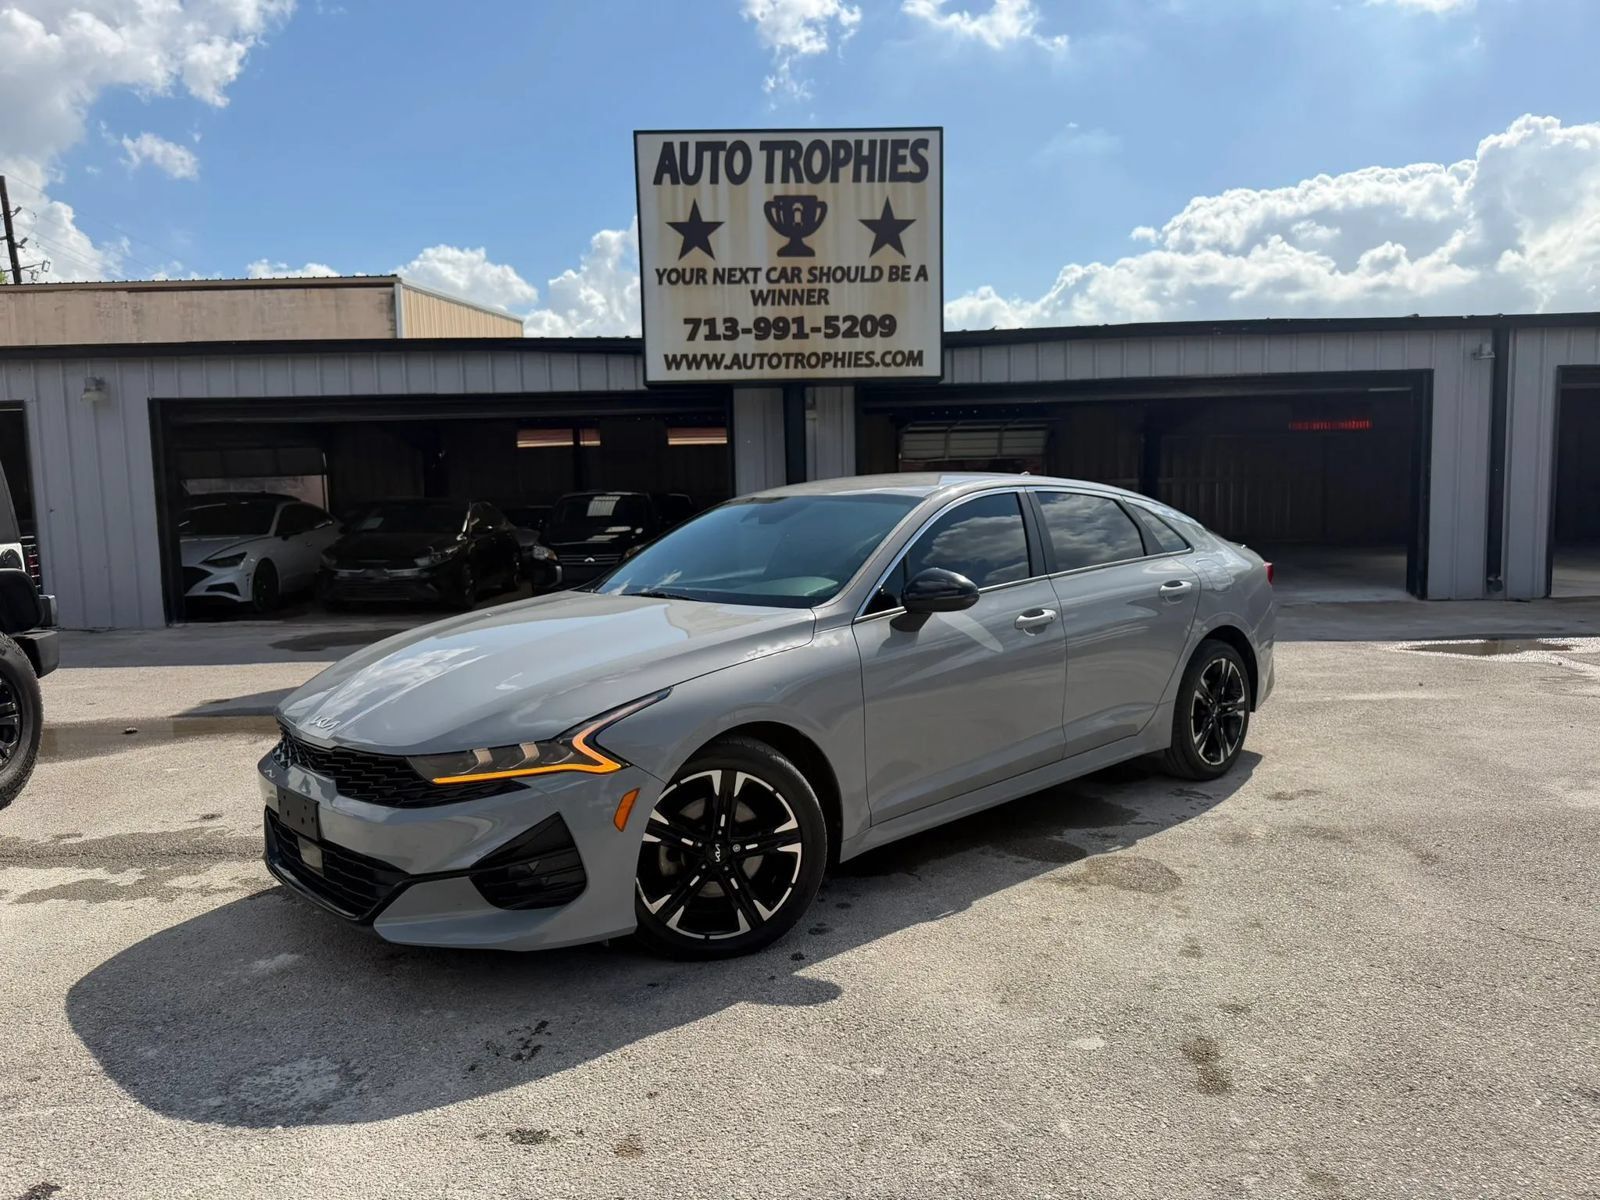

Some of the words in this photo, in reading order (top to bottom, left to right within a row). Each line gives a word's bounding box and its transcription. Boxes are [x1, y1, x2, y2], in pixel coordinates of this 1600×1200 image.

[653, 140, 752, 185] AUTO
[759, 138, 930, 184] TROPHIES
[655, 268, 707, 285] YOUR
[712, 267, 762, 284] NEXT
[765, 267, 803, 284] CAR
[806, 266, 883, 283] SHOULD
[887, 265, 911, 282] BE
[914, 265, 929, 282] A
[750, 289, 830, 306] WINNER
[683, 314, 897, 341] 713-991-5209
[663, 350, 924, 370] WWW.AUTOTROPHIES.COM
